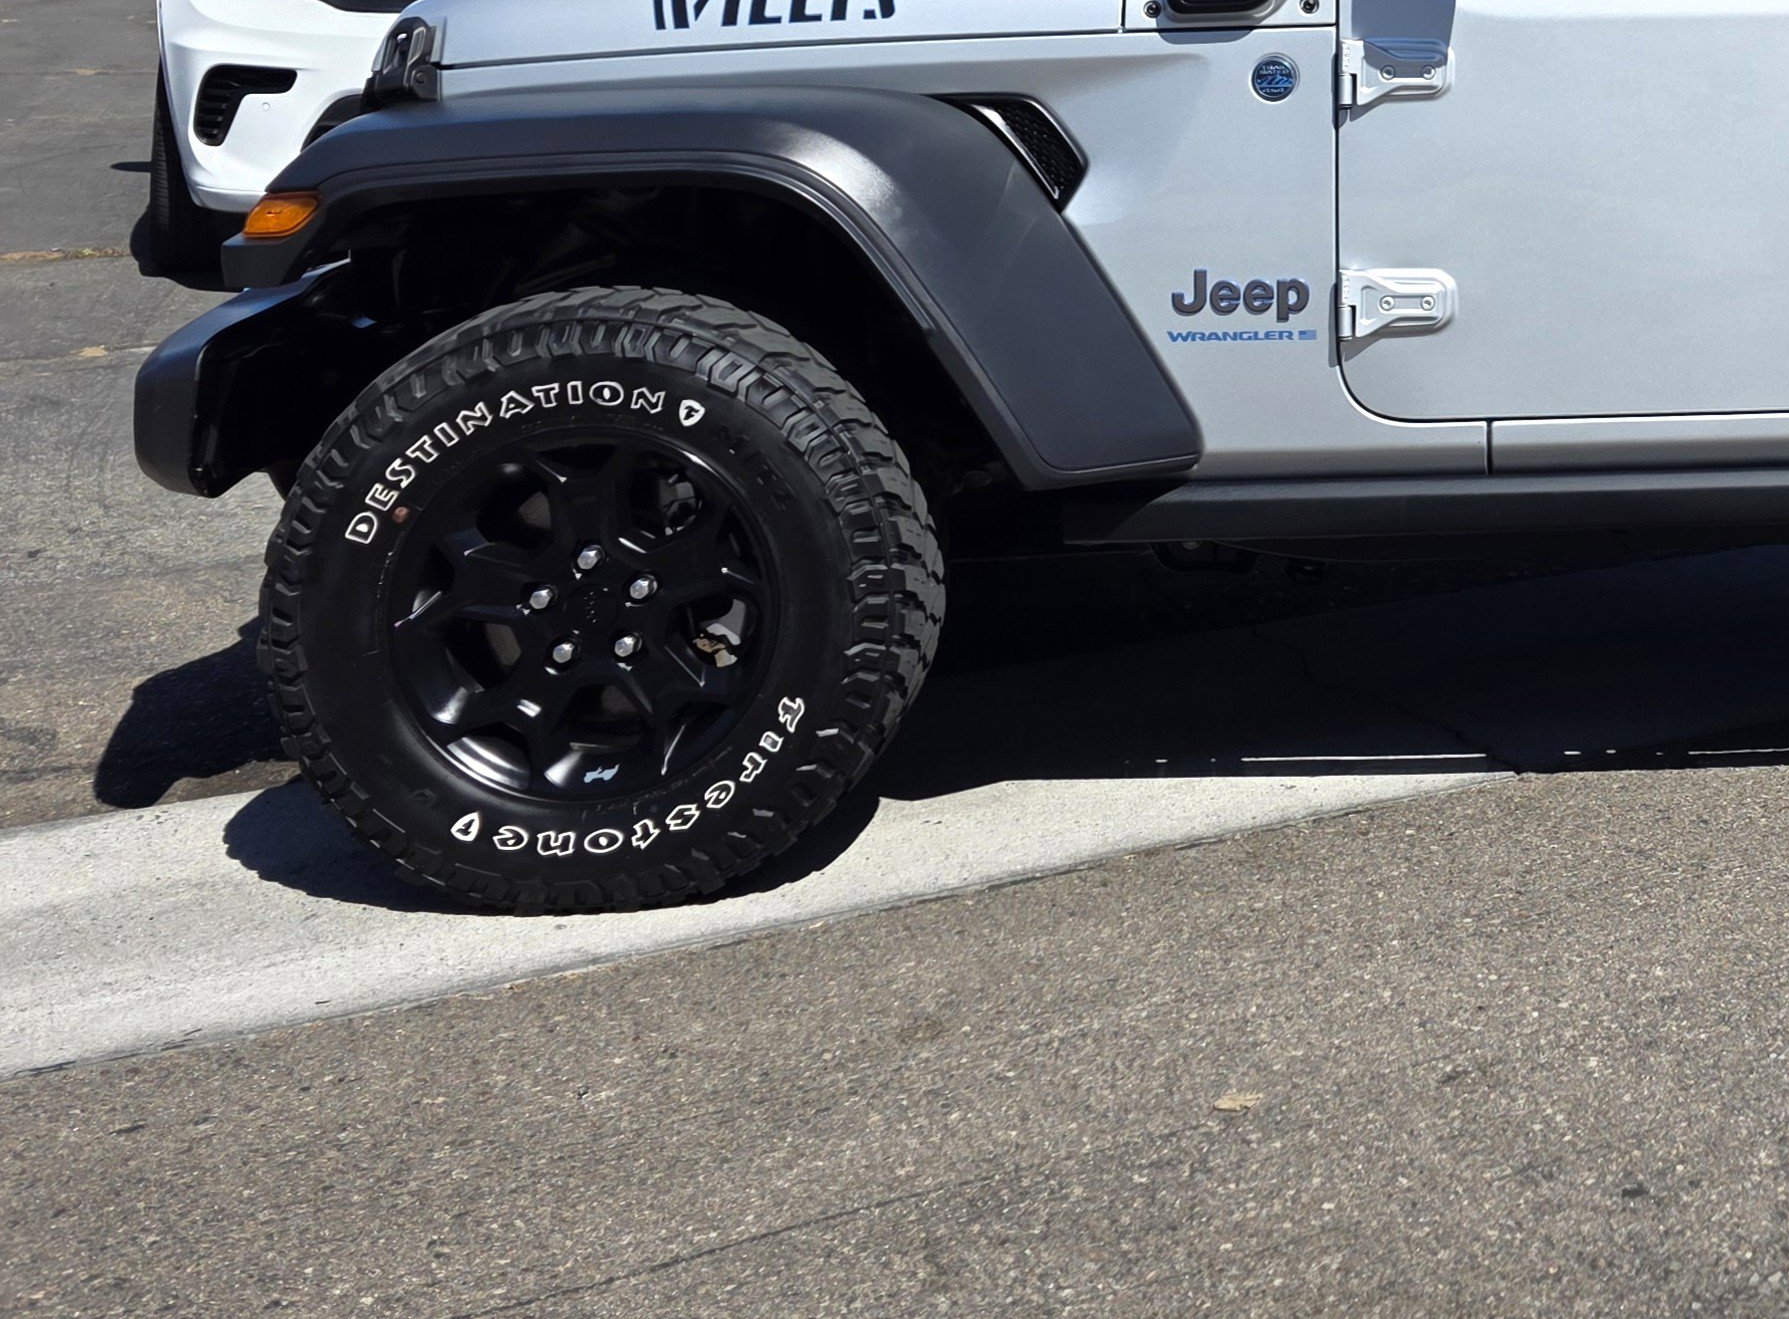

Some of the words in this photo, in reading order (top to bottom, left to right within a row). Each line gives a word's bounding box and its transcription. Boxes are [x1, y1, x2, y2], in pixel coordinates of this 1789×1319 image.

[1166, 330, 1294, 343] WRANGLER
[1171, 269, 1310, 323] Jeep
[345, 379, 666, 545] DESTINATION
[491, 695, 806, 856] Firestone
